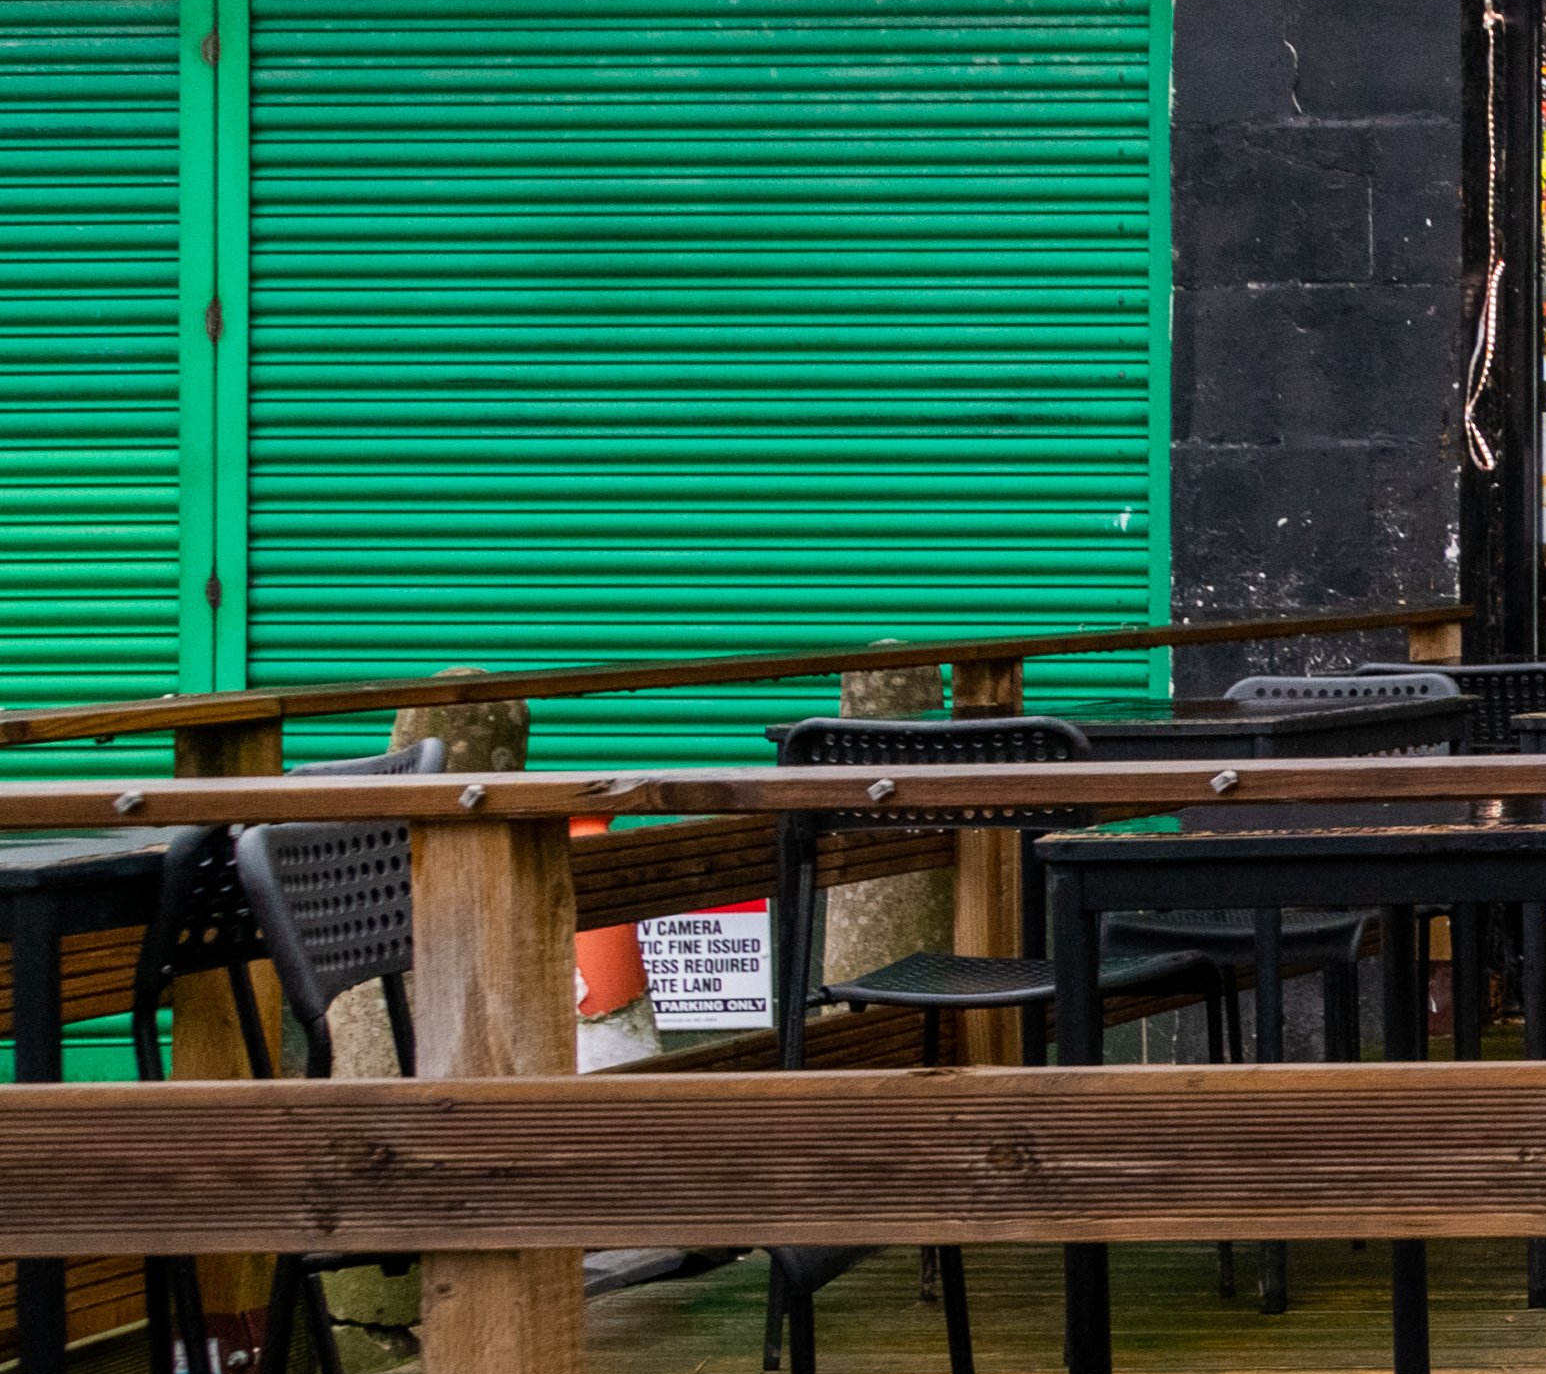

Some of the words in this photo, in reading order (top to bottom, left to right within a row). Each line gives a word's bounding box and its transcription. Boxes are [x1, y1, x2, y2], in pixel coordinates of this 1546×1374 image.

[657, 920, 722, 936] CAMERA
[669, 939, 701, 954] FINE
[707, 938, 760, 954] ISSUED
[684, 958, 760, 974] REQUIRED
[683, 978, 722, 993] LAND
[661, 1001, 723, 1013] PARKING
[727, 999, 766, 1012] ONLY
